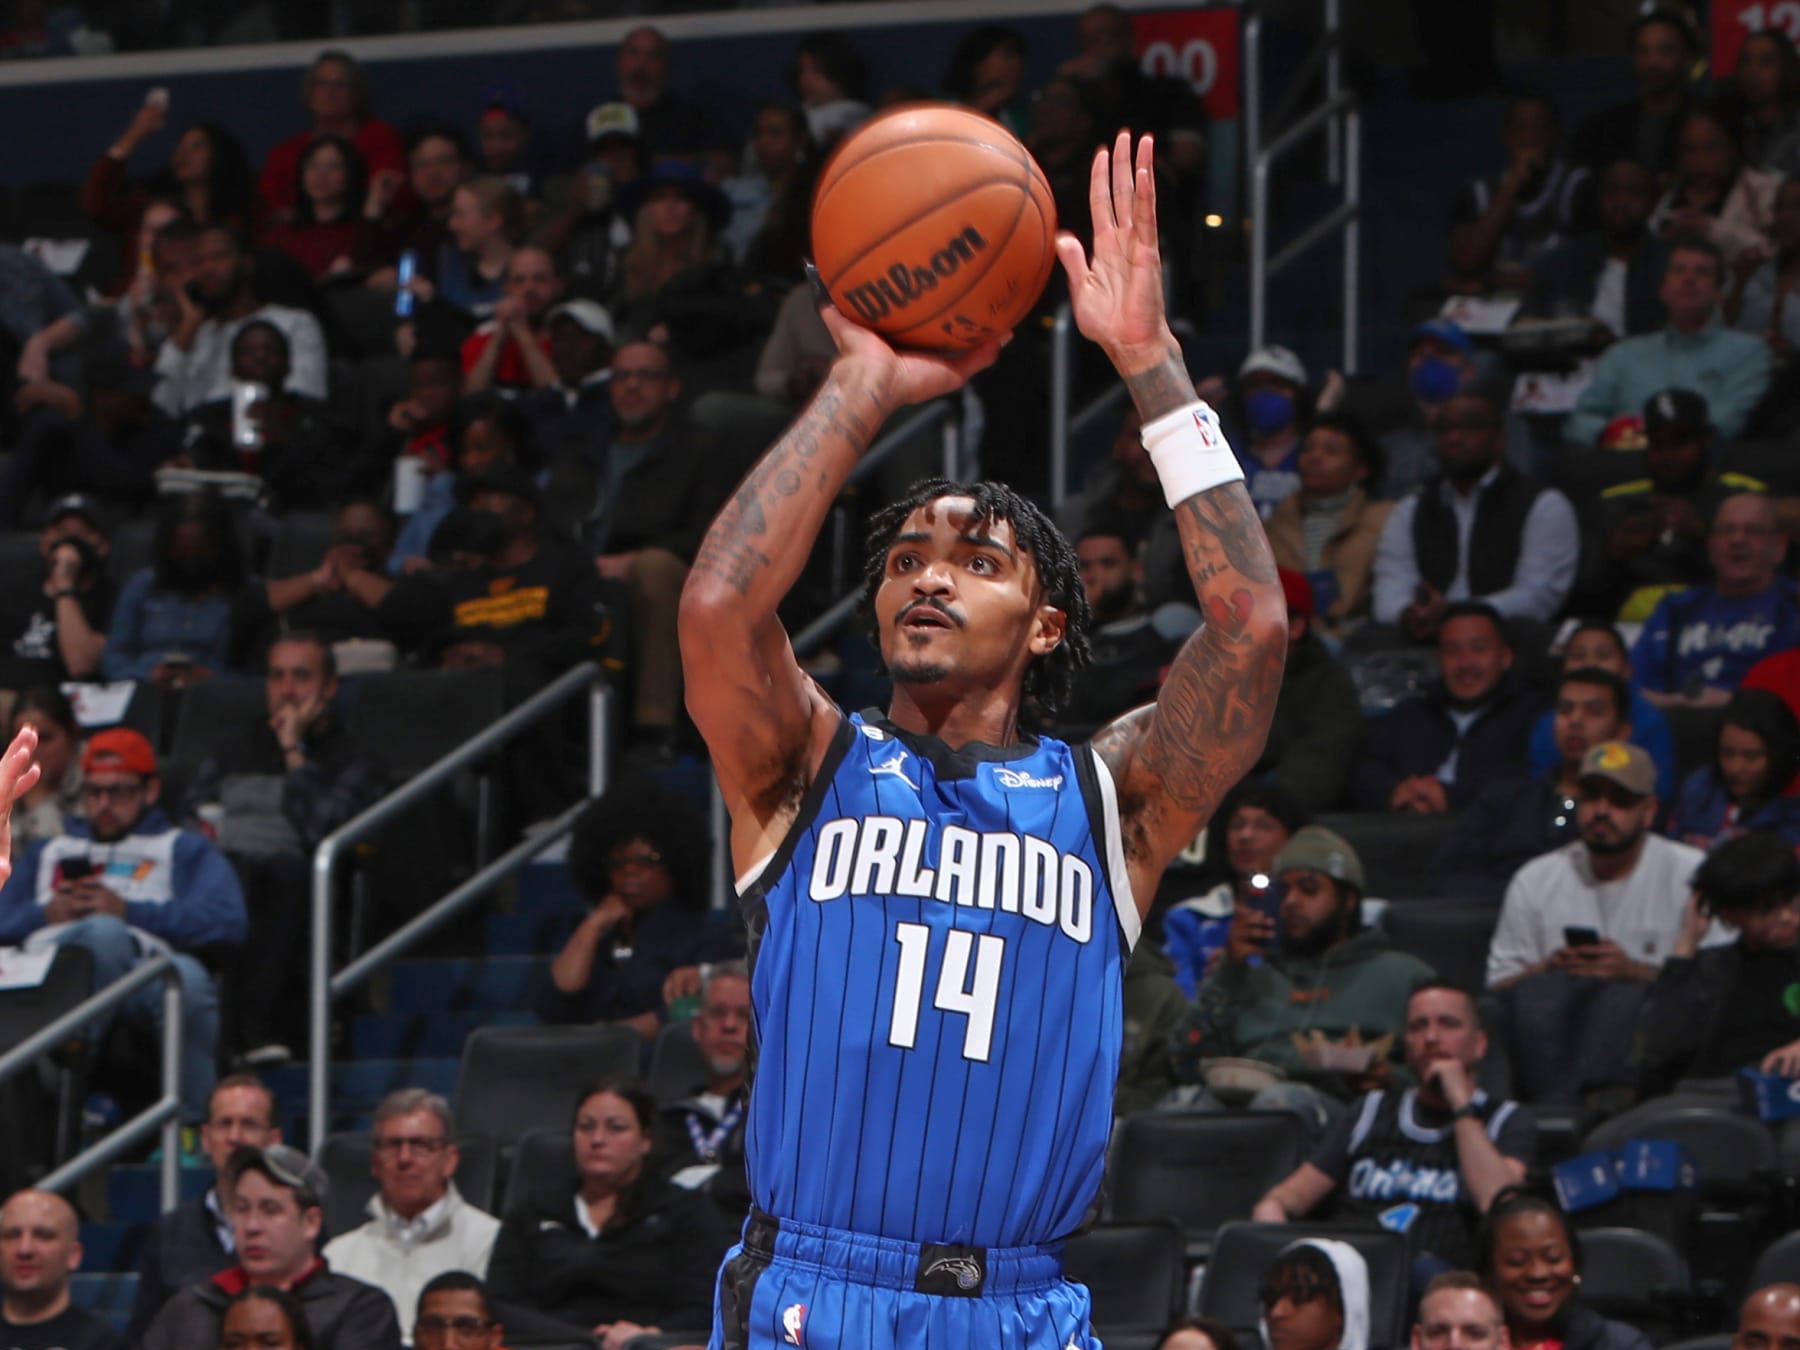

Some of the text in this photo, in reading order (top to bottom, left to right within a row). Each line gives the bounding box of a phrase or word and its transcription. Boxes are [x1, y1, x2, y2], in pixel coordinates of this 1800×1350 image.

[843, 225, 986, 323] Wilson
[992, 767, 1063, 792] Disney
[809, 816, 1093, 945] ORLANDO
[888, 921, 1005, 1063] 14
